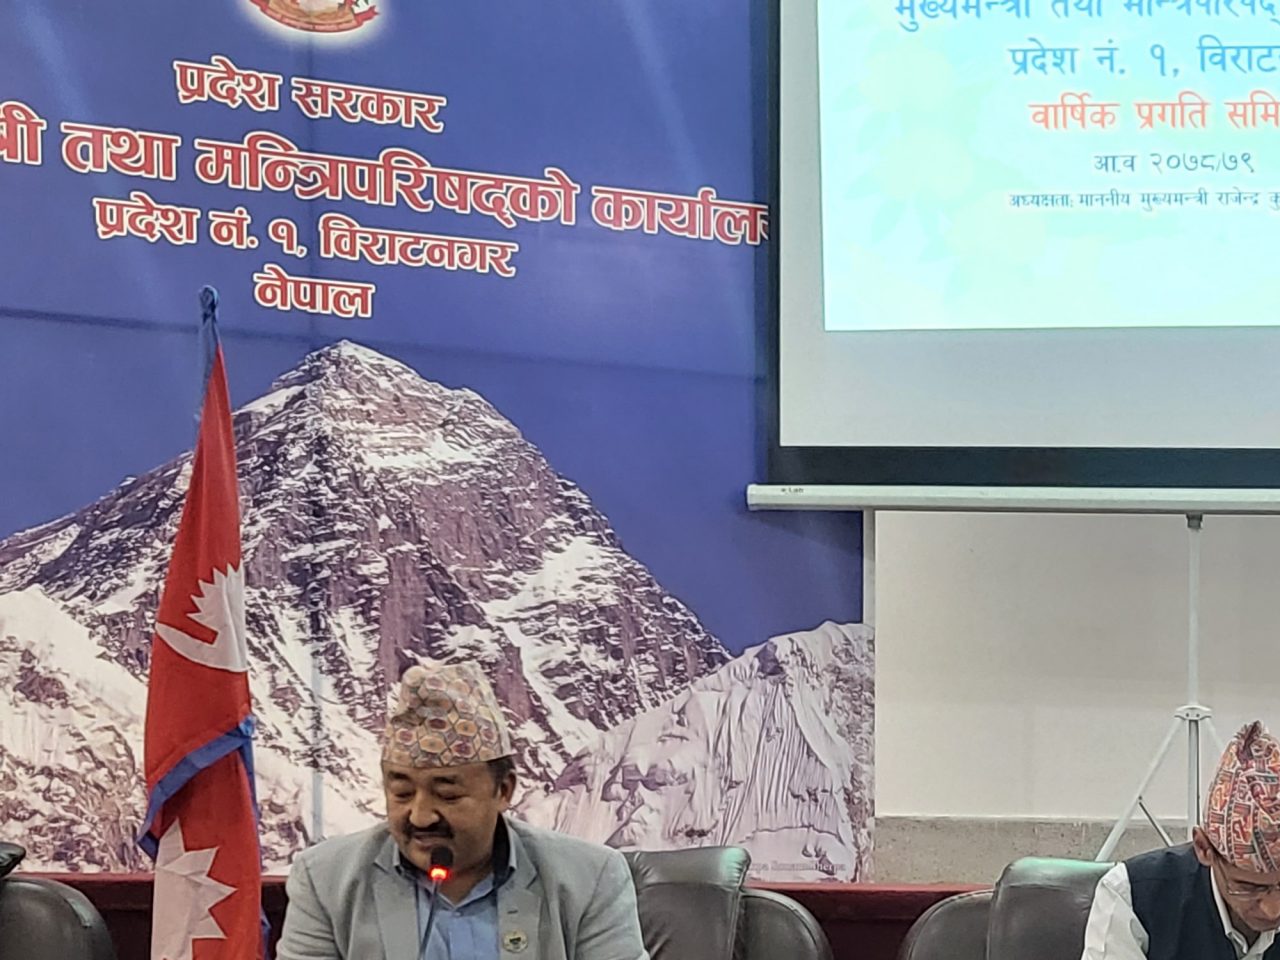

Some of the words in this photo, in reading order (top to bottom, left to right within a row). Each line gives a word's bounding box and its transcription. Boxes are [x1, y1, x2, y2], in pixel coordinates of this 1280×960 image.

[1006, 36, 1081, 76] प्रदेश
[1092, 38, 1126, 75] नं.
[173, 55, 281, 112] प्रदेश
[292, 76, 447, 133] सरकार
[1027, 91, 1121, 130] वार्षिक
[1133, 90, 1211, 129] प्रगति
[60, 121, 182, 181] तथा
[194, 130, 580, 228] मन्त्रिपरिषद्को
[591, 186, 770, 246] कार्याल
[1078, 187, 1131, 208] माननीय
[92, 191, 200, 245] प्रदेश
[208, 206, 259, 250] नं.
[267, 217, 307, 259] १,
[319, 212, 519, 278] विराटनगर
[253, 264, 376, 318] नेपाल
